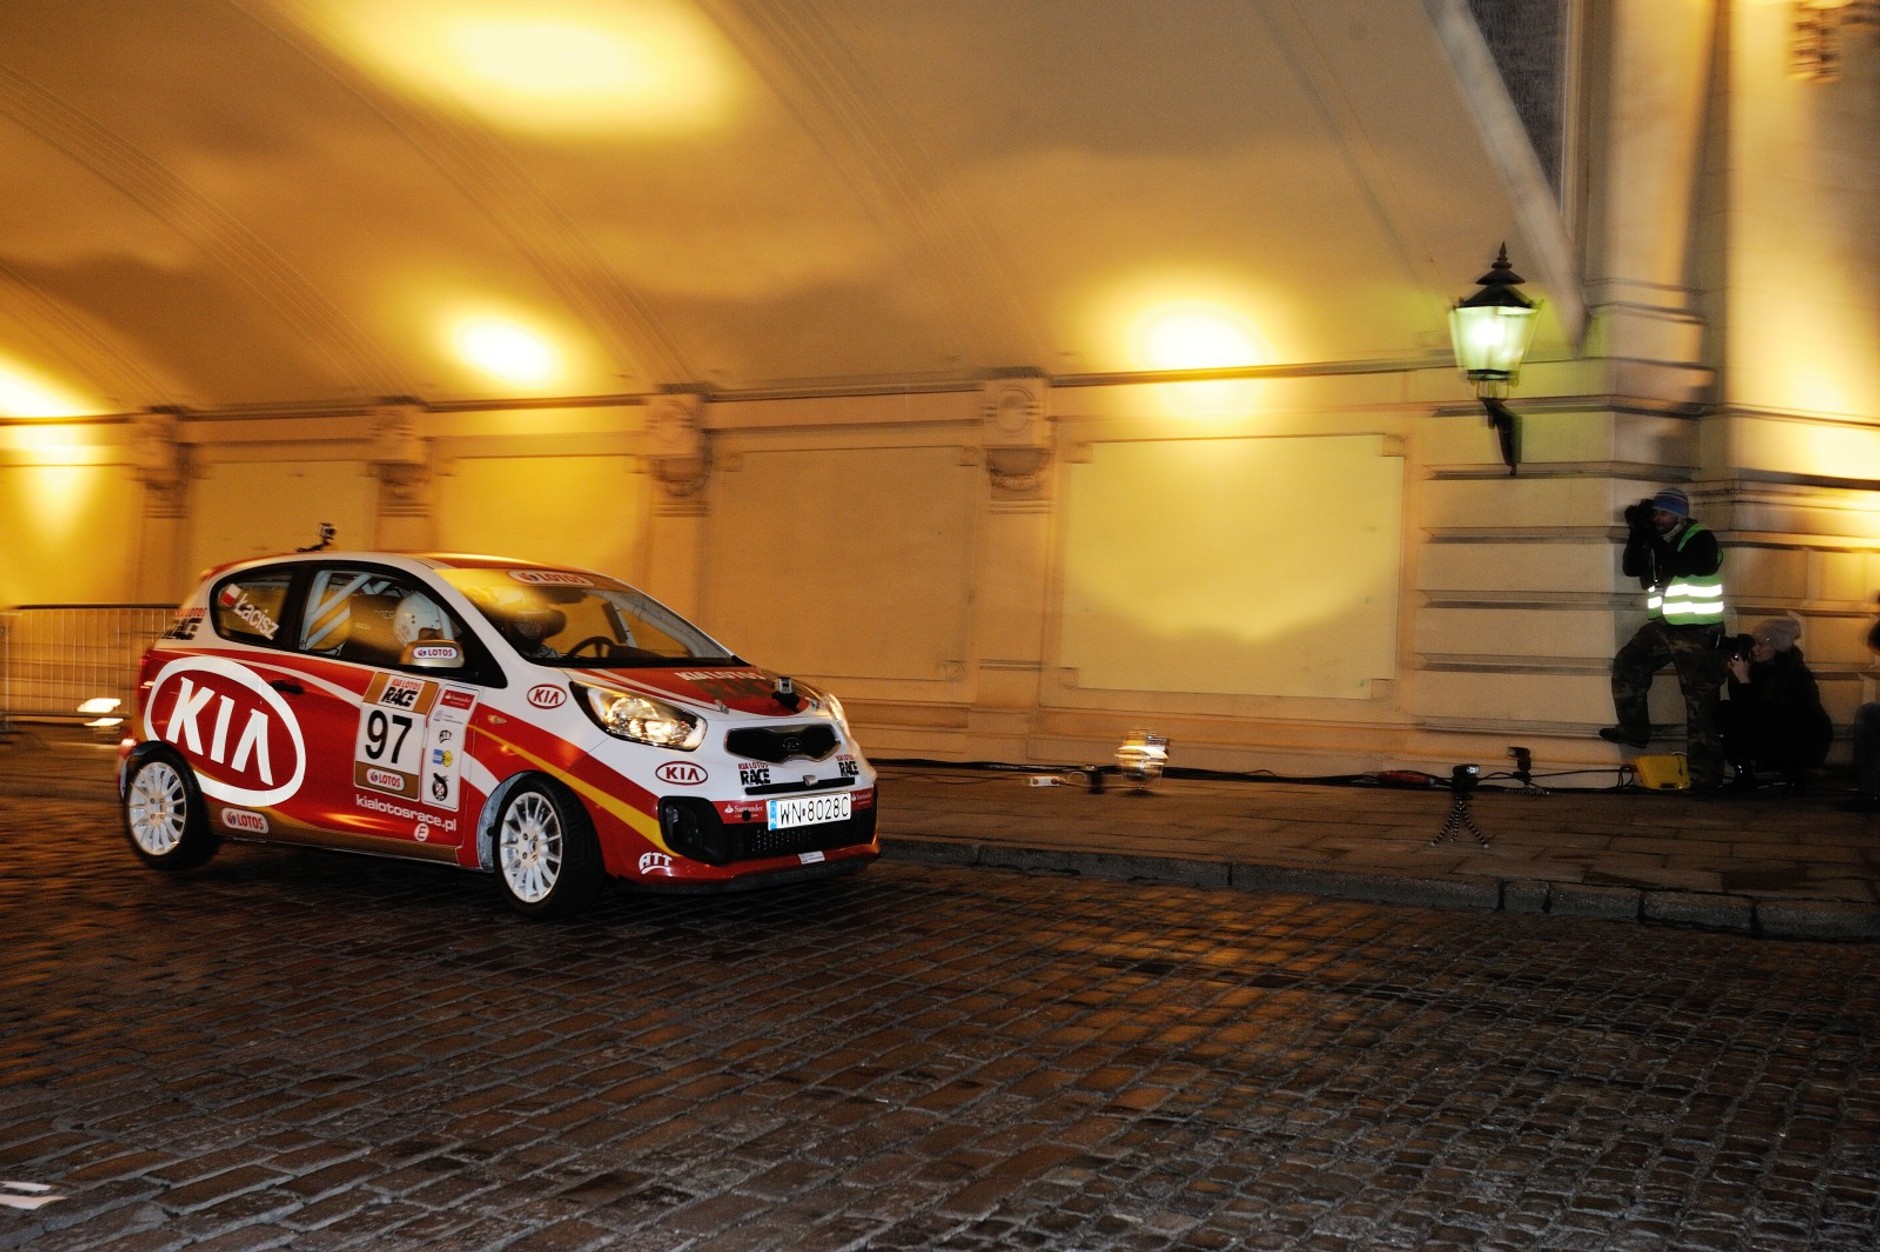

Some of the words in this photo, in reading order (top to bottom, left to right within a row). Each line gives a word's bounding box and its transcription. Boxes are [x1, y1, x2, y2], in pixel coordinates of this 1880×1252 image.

[427, 648, 453, 657] LOTOS
[381, 686, 419, 707] RACE
[533, 689, 559, 704] KIA
[165, 676, 274, 786] KIA
[365, 709, 413, 764] 97
[665, 766, 701, 781] KIA
[740, 768, 771, 786] RACE
[838, 760, 860, 777] RACE
[379, 774, 401, 788] LOTOS
[237, 813, 265, 830] LOTOS
[356, 794, 457, 832] kialotosrace.pl
[638, 852, 673, 870] ATT
